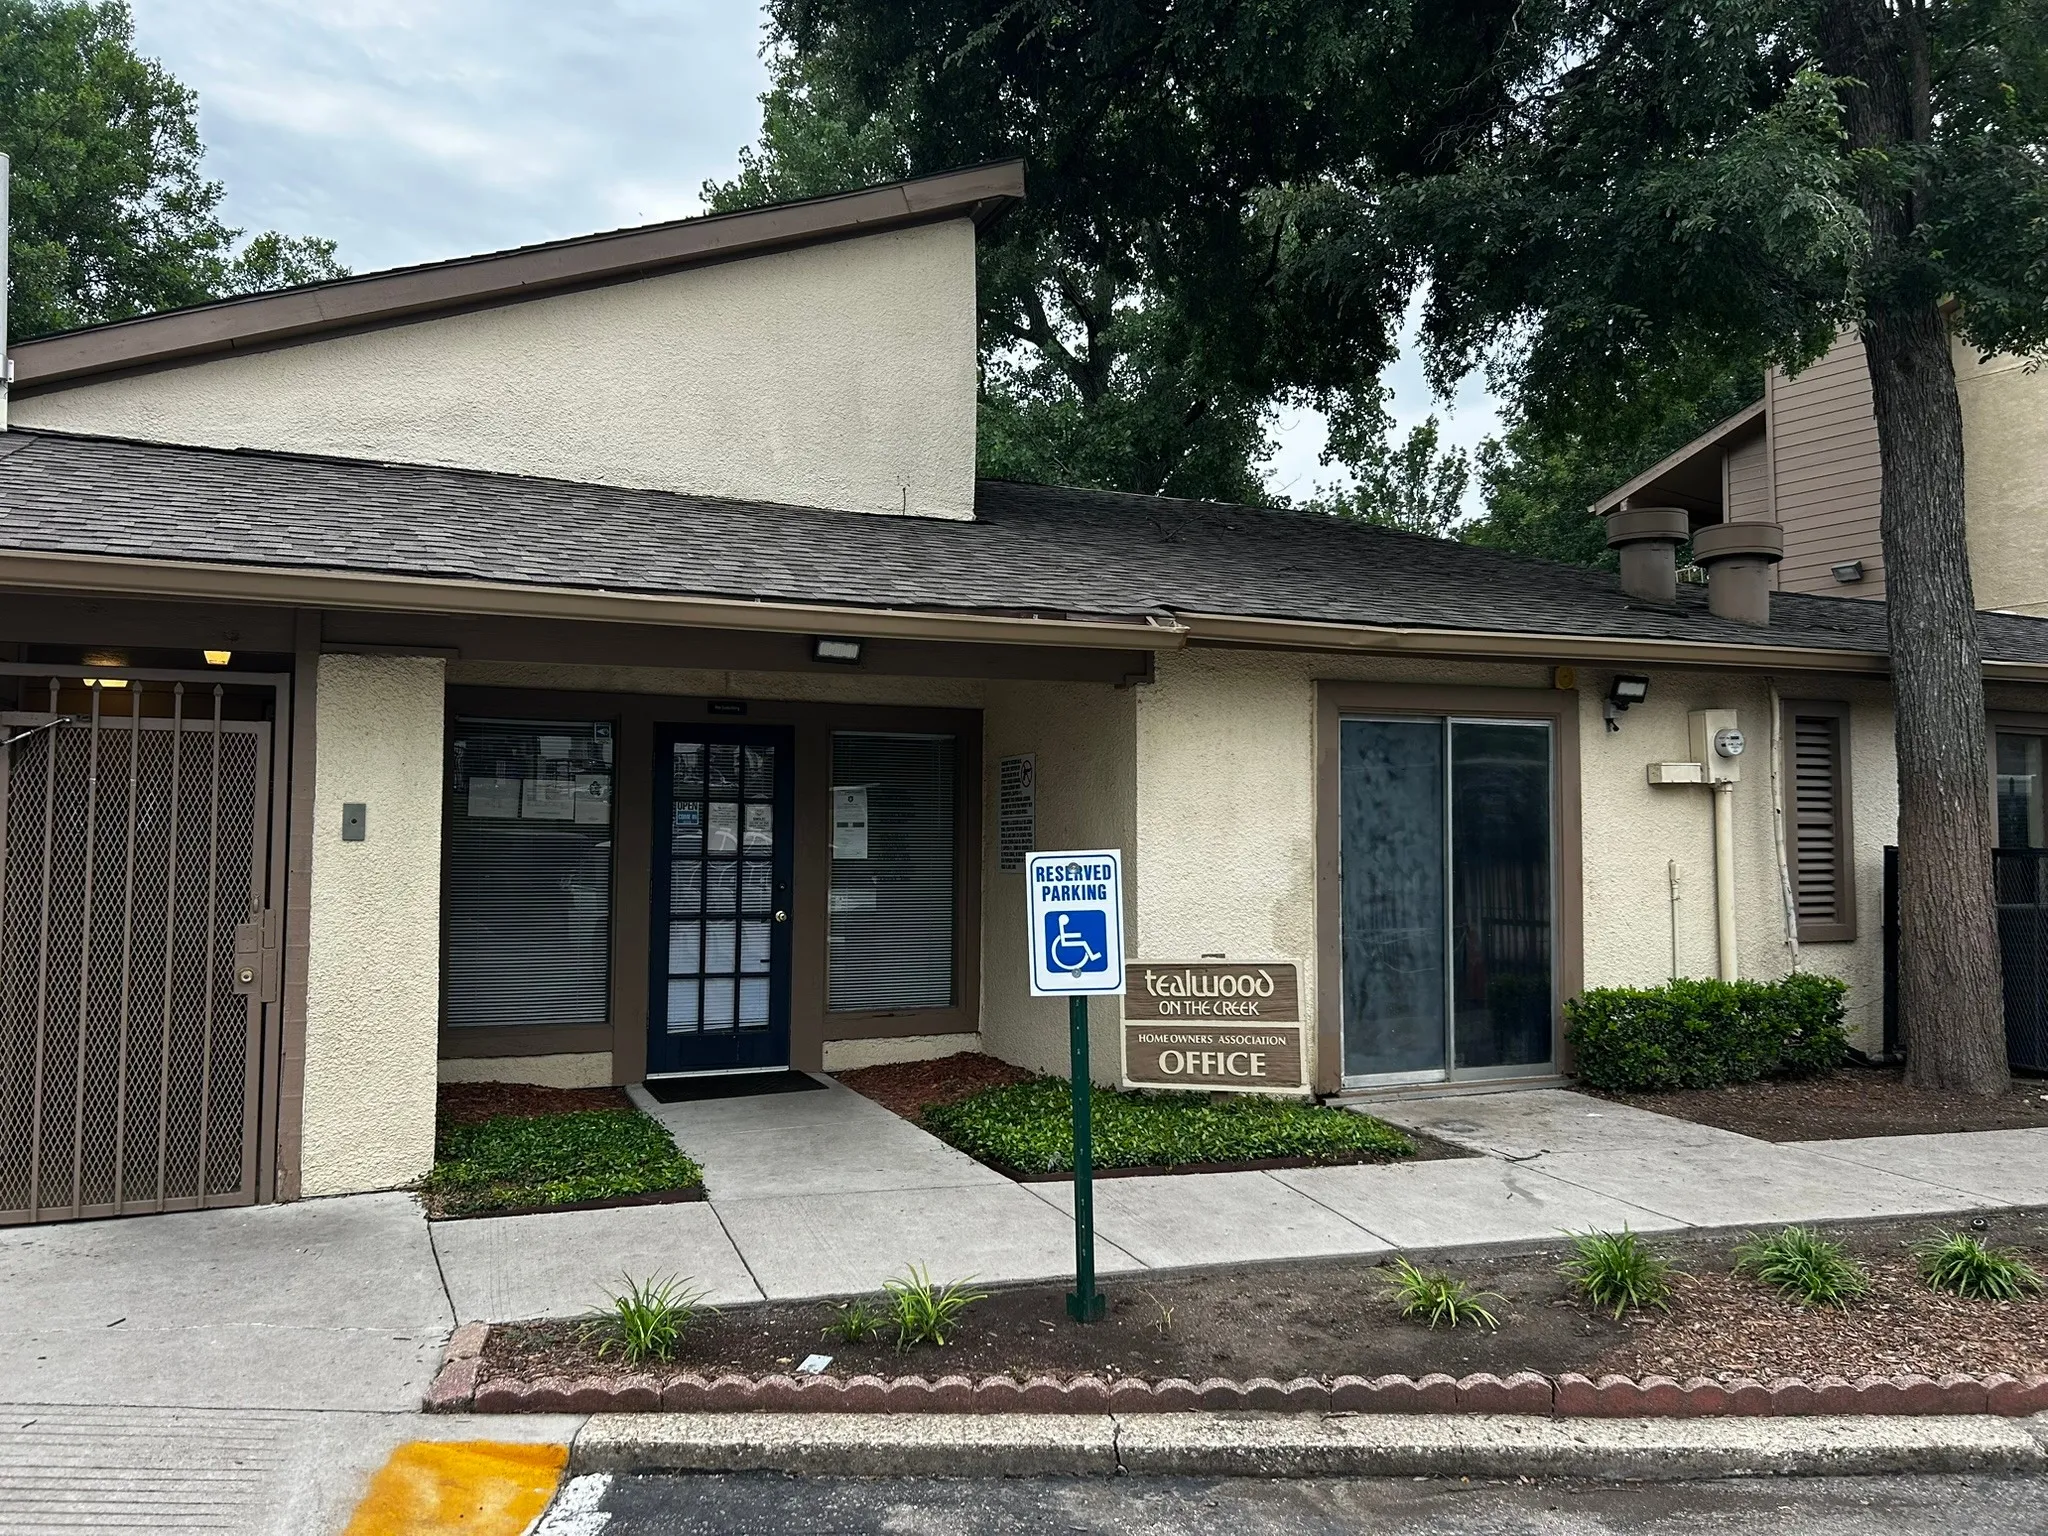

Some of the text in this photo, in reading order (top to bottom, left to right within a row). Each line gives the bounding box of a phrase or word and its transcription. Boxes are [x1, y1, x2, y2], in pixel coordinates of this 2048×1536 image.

[1036, 864, 1112, 883] RESERVED
[1042, 884, 1107, 902] PARKING
[1159, 1001, 1260, 1017] ON THE CREEK
[1218, 1035, 1287, 1046] ASSOCIATION
[1158, 1050, 1267, 1077] OFFICE
